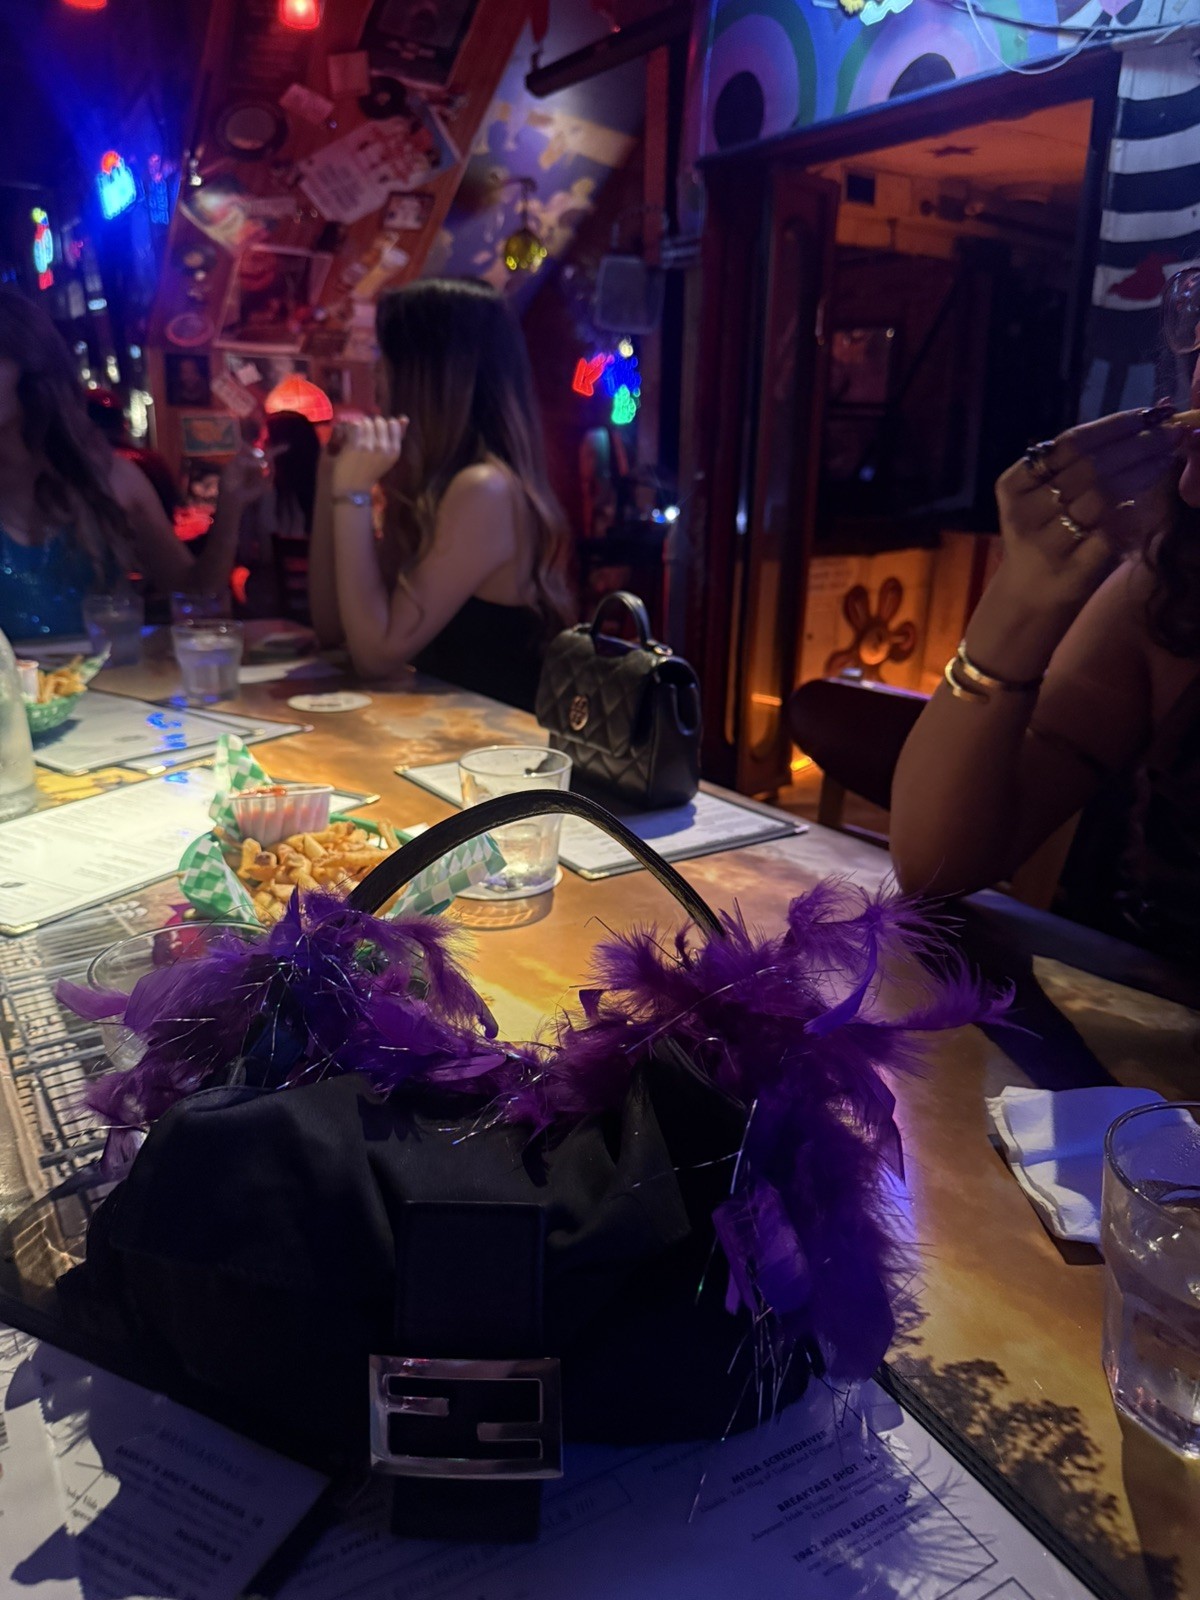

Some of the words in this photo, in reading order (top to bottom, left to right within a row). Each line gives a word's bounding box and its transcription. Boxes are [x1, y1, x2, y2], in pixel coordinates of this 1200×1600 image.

[730, 1463, 761, 1484] MEGA
[762, 1429, 828, 1467] SCREWDRIVER
[776, 1477, 832, 1512] BREAKFAST
[832, 1462, 859, 1481] SHOT
[863, 1452, 878, 1464] 14
[791, 1543, 820, 1563] 1942
[849, 1503, 889, 1530] BUCKET
